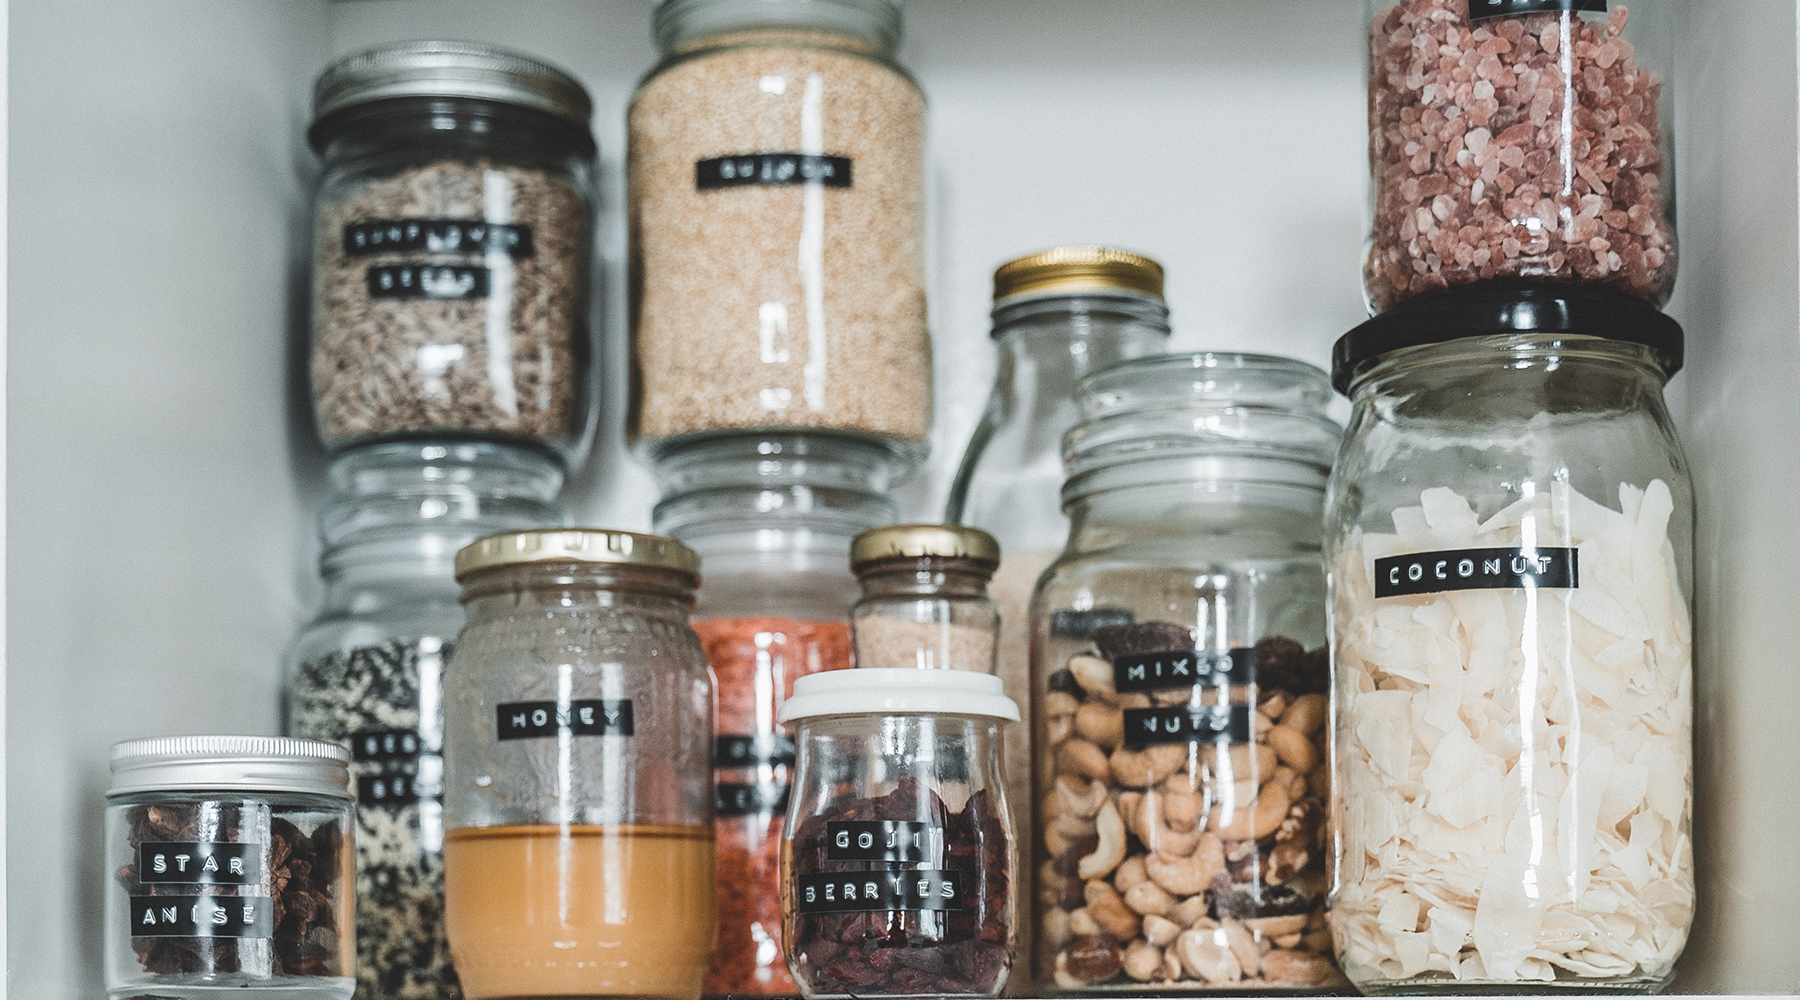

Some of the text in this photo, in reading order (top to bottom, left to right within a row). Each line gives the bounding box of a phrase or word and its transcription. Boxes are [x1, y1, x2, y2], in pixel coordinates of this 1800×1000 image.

[1389, 556, 1552, 586] COCONUT
[1127, 654, 1234, 681] MIXED
[512, 706, 620, 729] HONEY
[1143, 712, 1230, 734] NUTS
[836, 829, 921, 849] GOJI
[153, 853, 245, 876] STAR
[805, 879, 955, 902] BERRIES
[142, 904, 256, 926] ANISE
